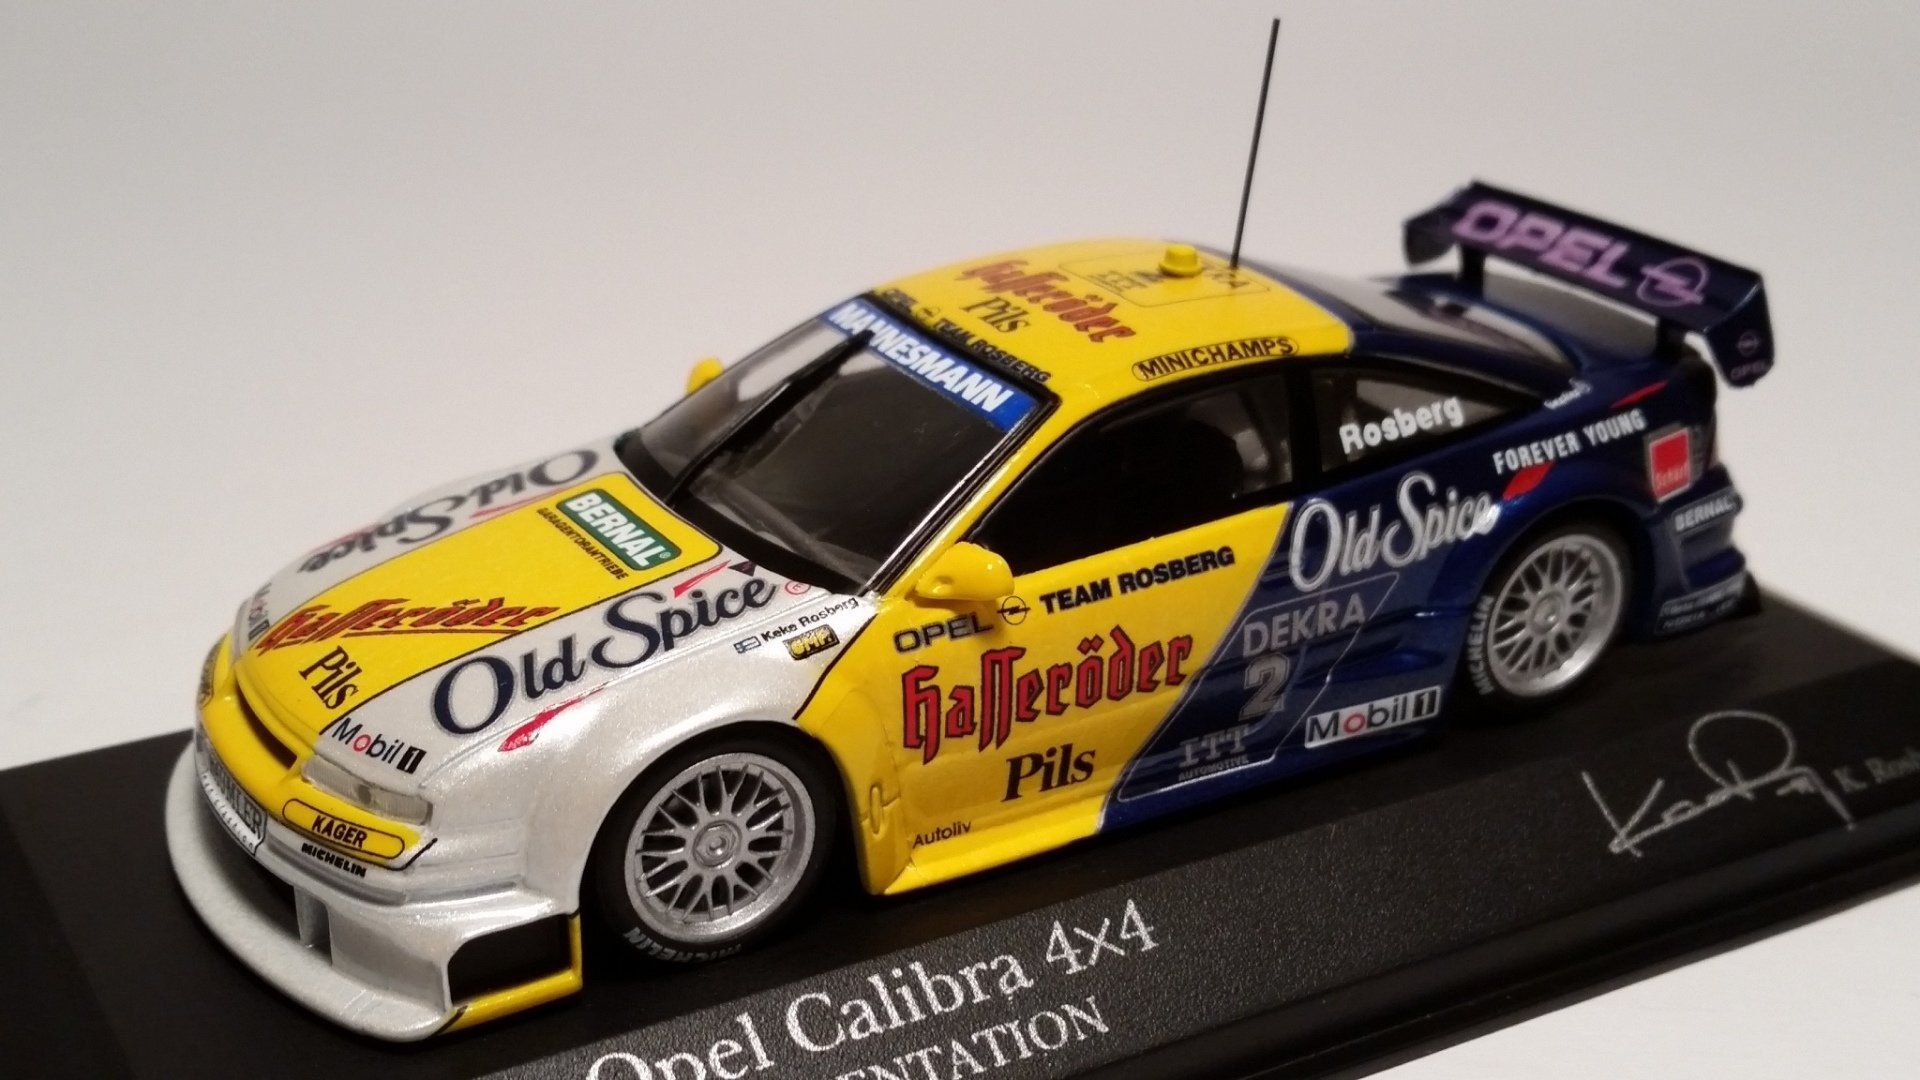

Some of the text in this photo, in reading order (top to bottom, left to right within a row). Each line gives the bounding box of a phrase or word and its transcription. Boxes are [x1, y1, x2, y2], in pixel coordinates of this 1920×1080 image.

[1452, 202, 1631, 289] OPEL
[959, 297, 1031, 333] Pils
[828, 304, 1013, 412] MANNESMANN
[1138, 336, 1293, 377] MINICHAMPS
[1339, 397, 1464, 454] Rosberg
[1493, 408, 1647, 475] FOREVER YOUNG
[472, 449, 598, 506] Old
[1289, 472, 1500, 592] Old Spice
[1675, 496, 1735, 532] BERNAL
[1039, 546, 1235, 614] TEAM ROSBERG
[761, 597, 859, 641] Keke Rosberg
[893, 612, 993, 653] OPEL
[1243, 593, 1365, 657] DEKRA
[299, 646, 365, 709] Pils
[433, 576, 776, 735] Old Spice
[1238, 652, 1290, 721] 2
[332, 717, 404, 764] Mobil
[1179, 723, 1248, 768] ITT
[1308, 695, 1407, 743] Mobil
[1001, 743, 1095, 802] Pils
[1178, 755, 1249, 781] AUTOMOTIVE
[301, 842, 367, 878] MICHELIN
[912, 822, 971, 848] Autoliv
[786, 952, 1033, 1053] Calibra
[1045, 899, 1159, 975] 4x4
